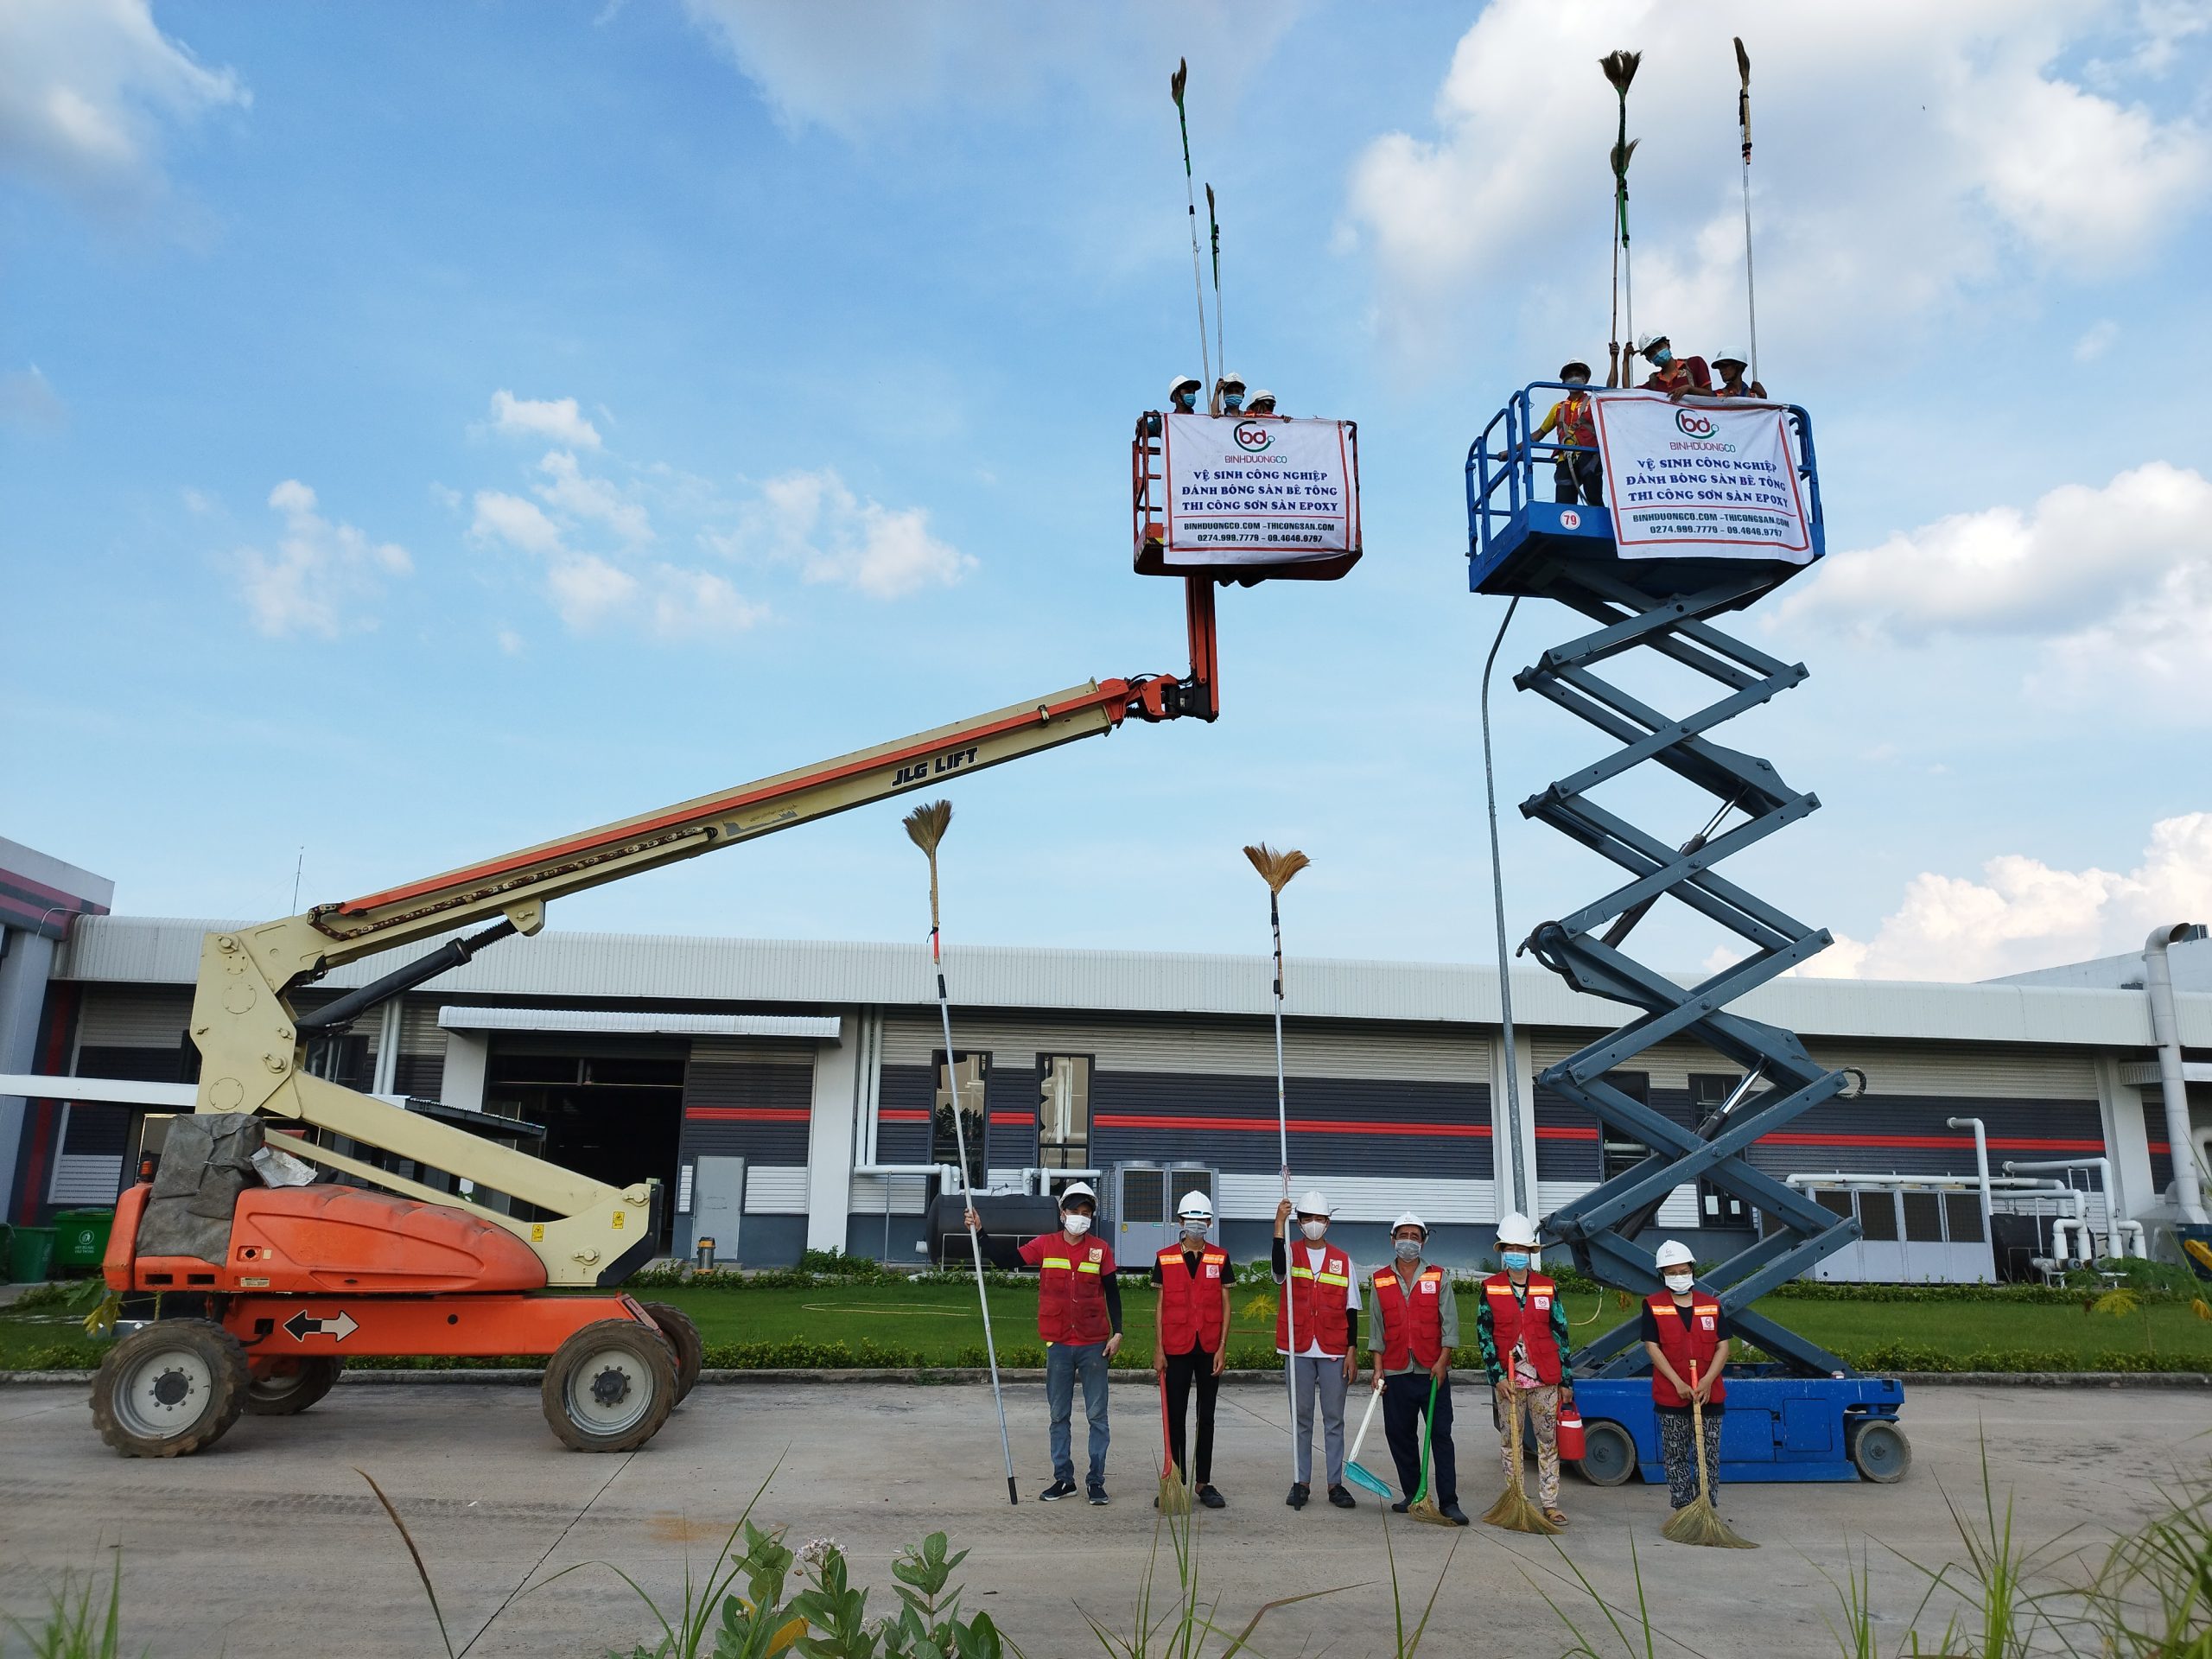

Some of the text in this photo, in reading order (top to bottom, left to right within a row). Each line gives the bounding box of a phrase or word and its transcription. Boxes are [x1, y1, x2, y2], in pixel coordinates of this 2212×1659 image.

[1669, 442, 1736, 453] BINHDUONGCO
[1224, 454, 1287, 464] BINHDUONGCO
[1637, 456, 1777, 474] VỆ SINH CÔNG NGHIỆP
[1193, 468, 1328, 482] VỆ SINH CÔNG NGHIỆP
[1625, 472, 1786, 492] ĐÁNH BÓNG SÀN BÊ TÔNG
[1181, 484, 1217, 495] ĐÁNH
[1221, 483, 1255, 495] BÓNG
[1286, 484, 1302, 495] BÊ
[1304, 484, 1338, 496] TÔNG
[1628, 487, 1789, 508] THI CÔNG SƠN SÀN EPOXY
[1181, 499, 1338, 512] THI CÔNG SƠN SÀN EPOXY
[1564, 514, 1577, 525] 79
[1632, 512, 1718, 523] BINHDUONGCO.COM
[1184, 522, 1261, 531] BINHDUONGCO.COM
[891, 747, 979, 788] JLG LIFT
